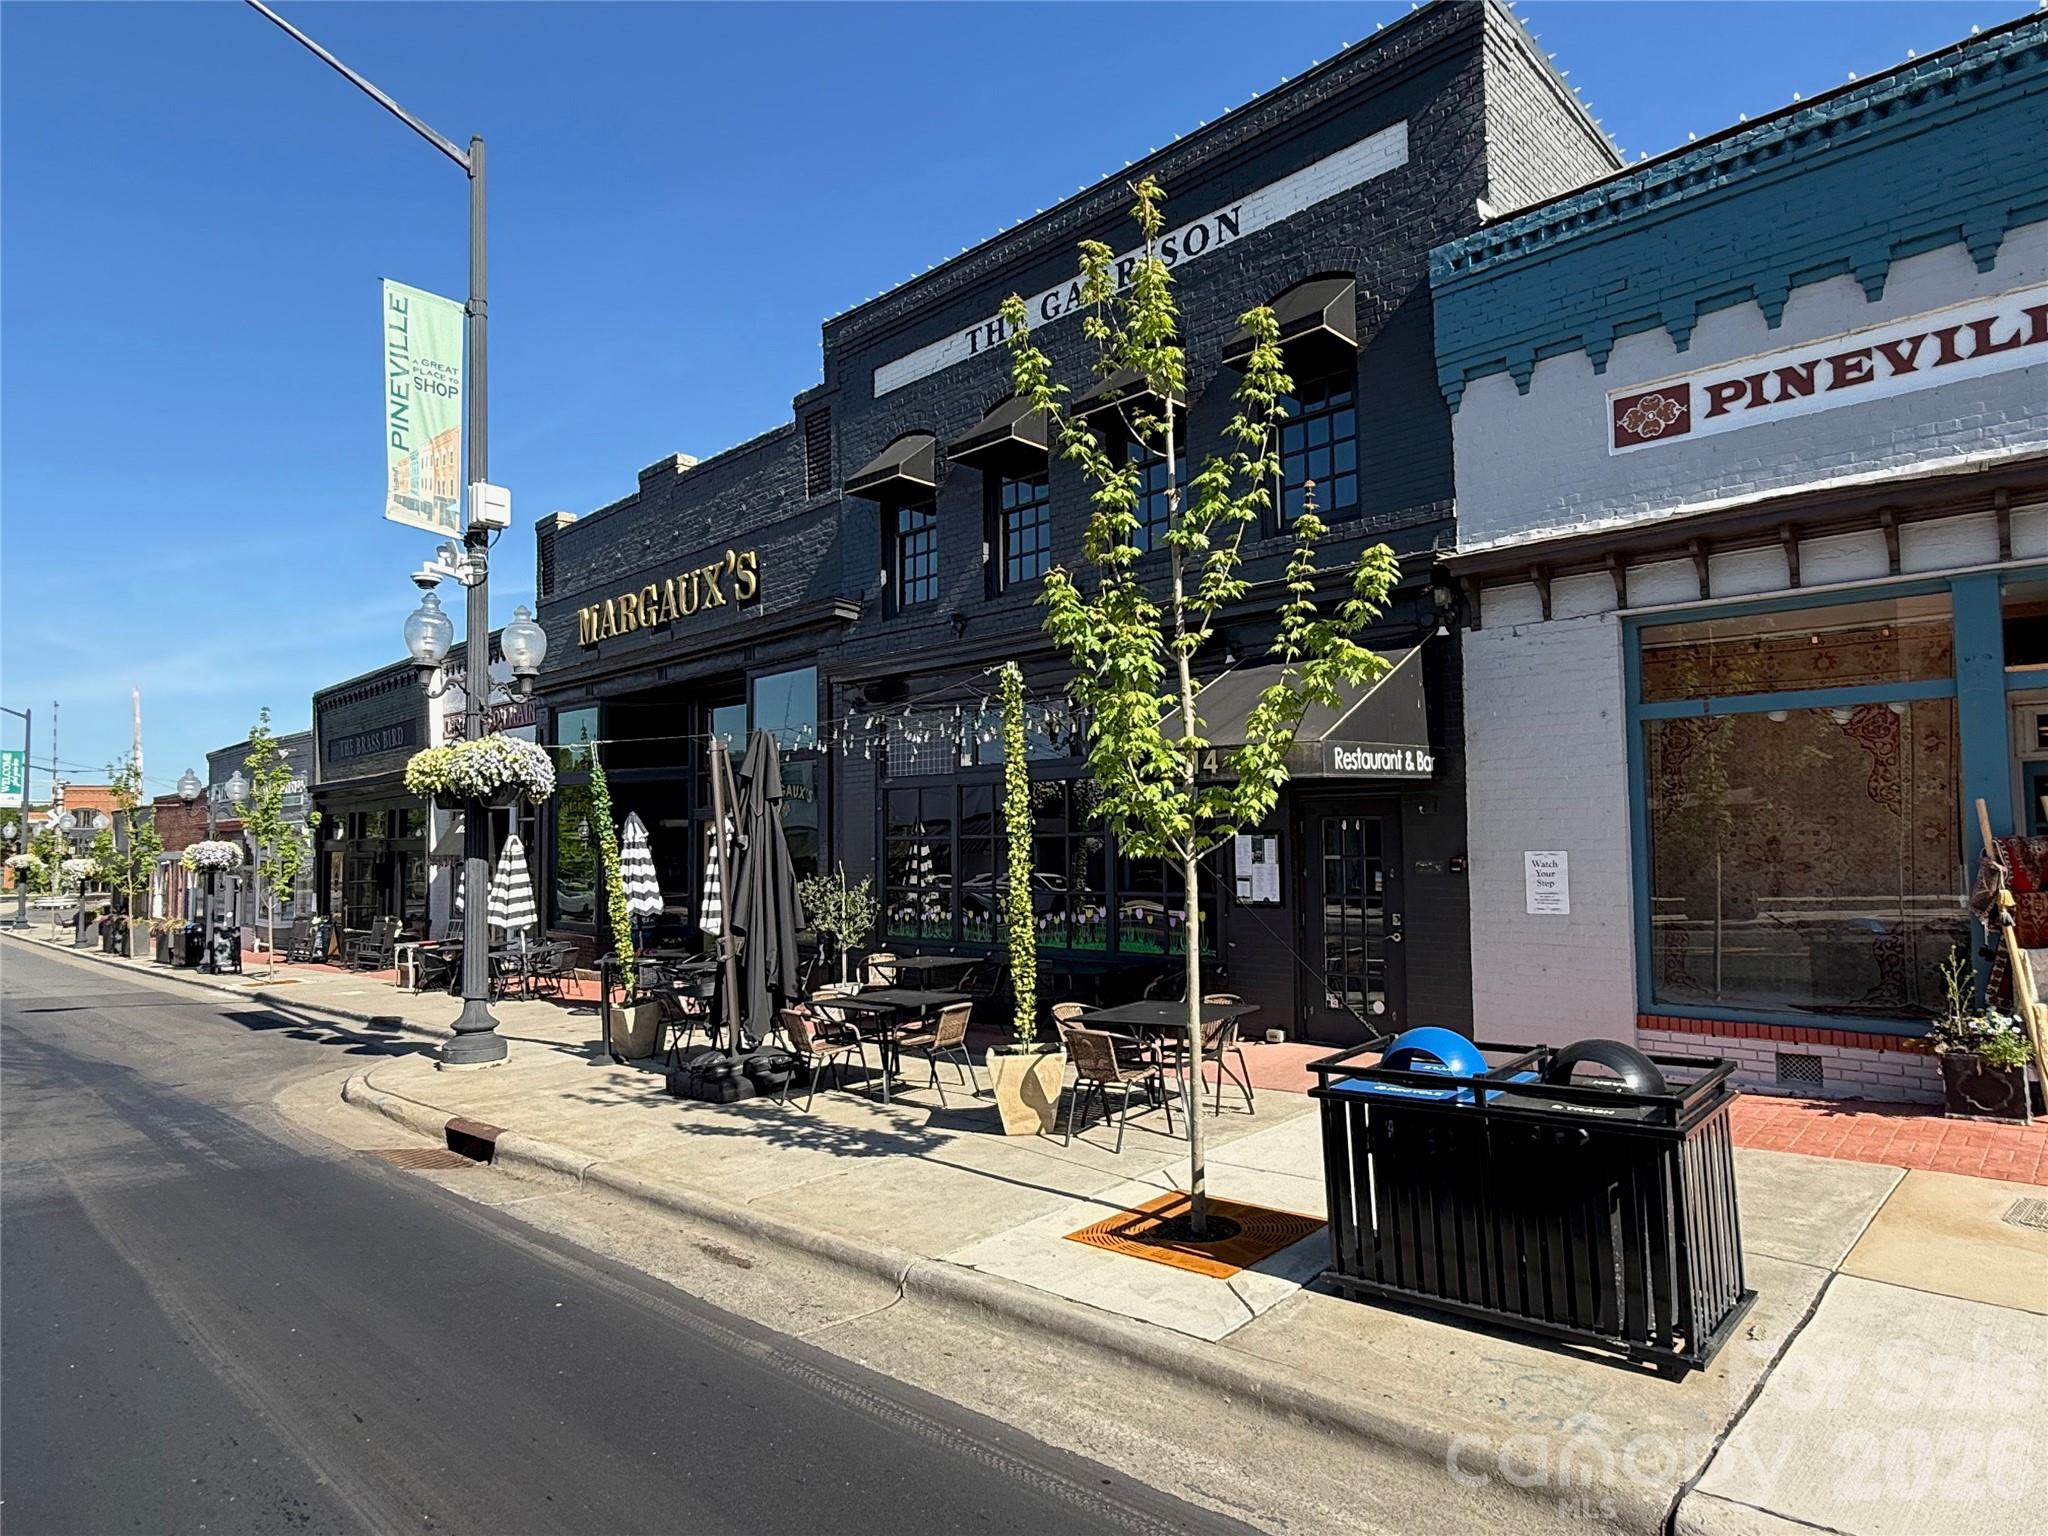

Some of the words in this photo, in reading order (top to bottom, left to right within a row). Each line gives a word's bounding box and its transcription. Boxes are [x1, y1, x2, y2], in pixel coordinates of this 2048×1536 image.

[1041, 206, 1243, 321] GARSON
[389, 292, 410, 453] PINEVILLE
[413, 366, 446, 381] PLACE
[449, 377, 459, 385] TO
[421, 358, 459, 375] GREAT
[414, 376, 459, 399] SHOP
[577, 549, 758, 646] MARGAUX'S
[340, 739, 354, 757] THE
[356, 733, 380, 754] BRASS
[382, 727, 404, 749] BIRD
[1334, 747, 1403, 770] Restaurant
[1405, 750, 1415, 771] &
[1416, 750, 1436, 772] Bar
[1531, 859, 1558, 868] Watch
[1536, 869, 1556, 878] Your
[1536, 879, 1555, 888] Step
